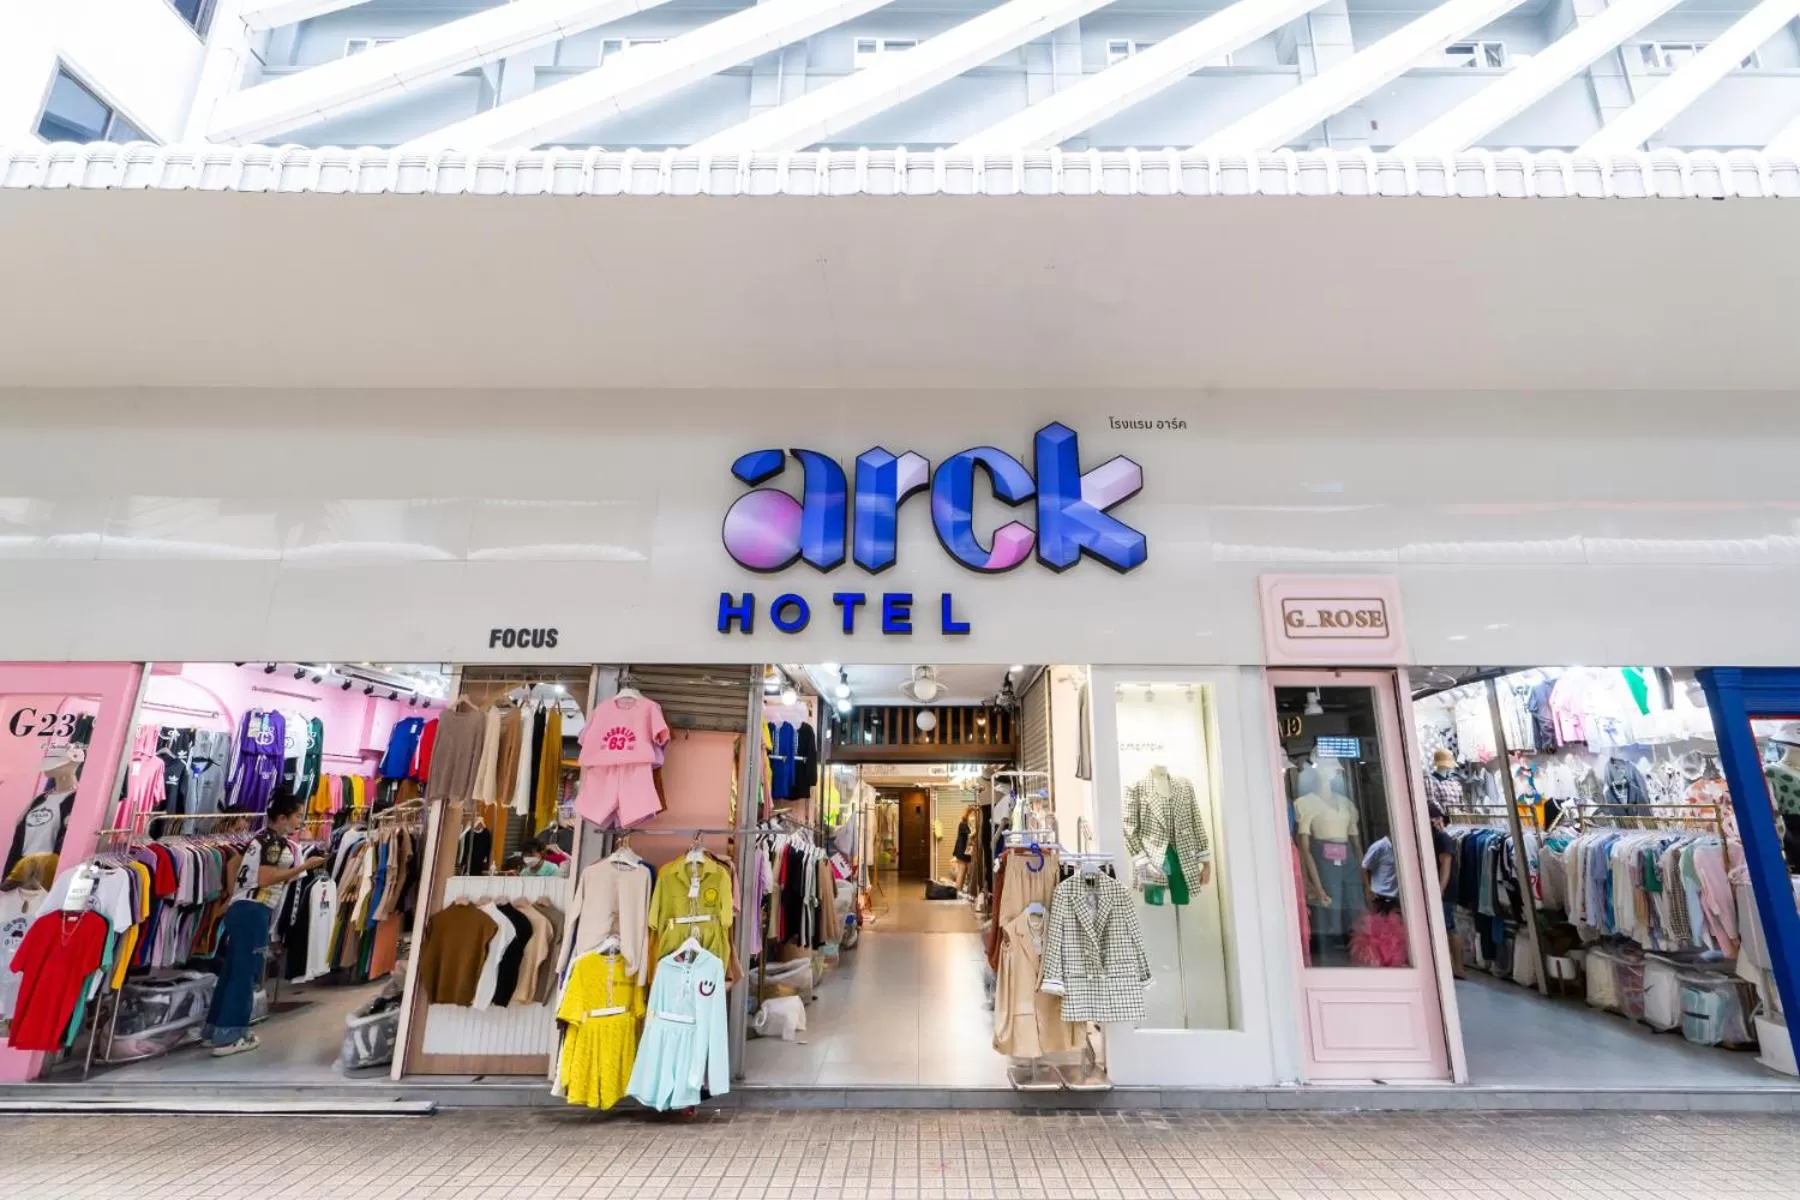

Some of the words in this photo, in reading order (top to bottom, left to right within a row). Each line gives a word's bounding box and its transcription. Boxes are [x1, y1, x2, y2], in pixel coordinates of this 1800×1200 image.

[1108, 415, 1153, 430] โรงแรม
[1156, 416, 1188, 430] อาร์ค
[722, 420, 1148, 575] arck
[717, 592, 971, 635] HOTEL
[1285, 608, 1384, 629] G_ROSE
[489, 627, 559, 649] FOCUS
